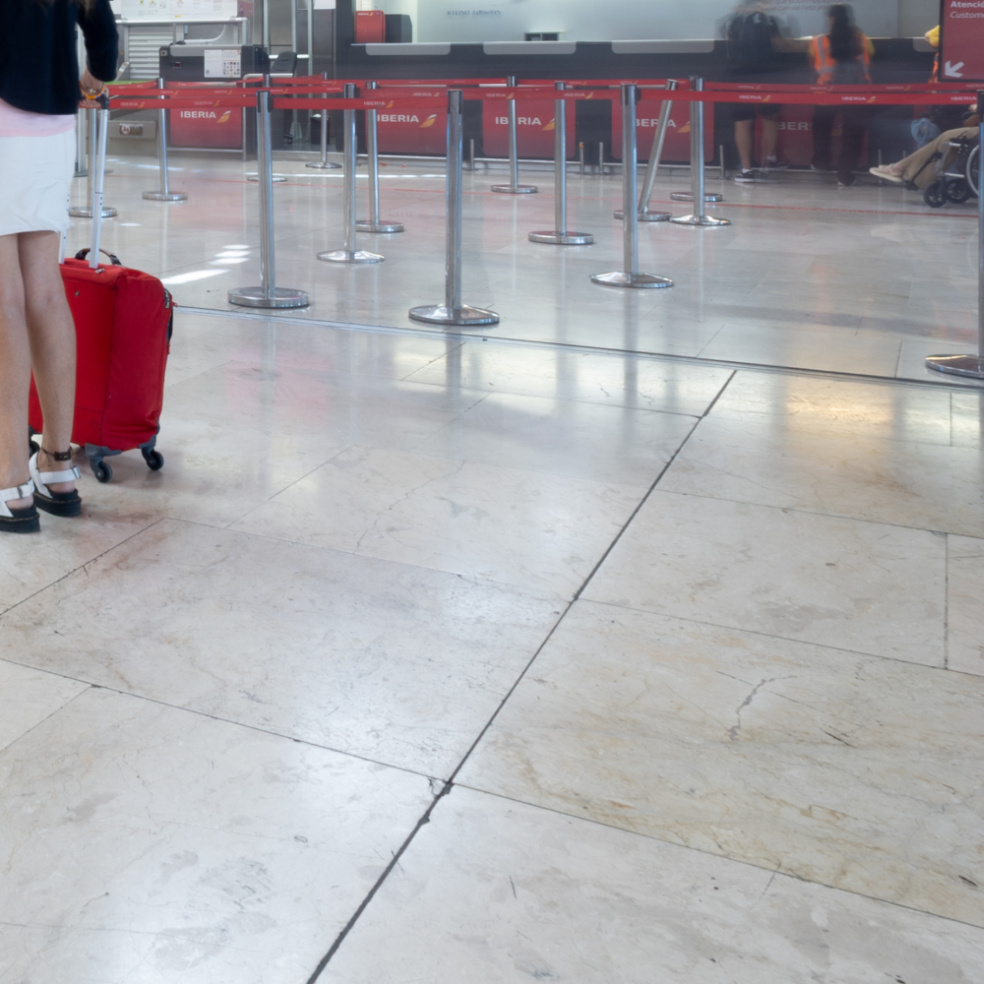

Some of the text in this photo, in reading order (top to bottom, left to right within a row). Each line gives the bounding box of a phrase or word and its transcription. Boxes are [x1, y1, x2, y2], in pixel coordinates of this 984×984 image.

[180, 110, 217, 119] IBERIA
[377, 114, 420, 123] IBERIA
[495, 116, 542, 126] IBRIA
